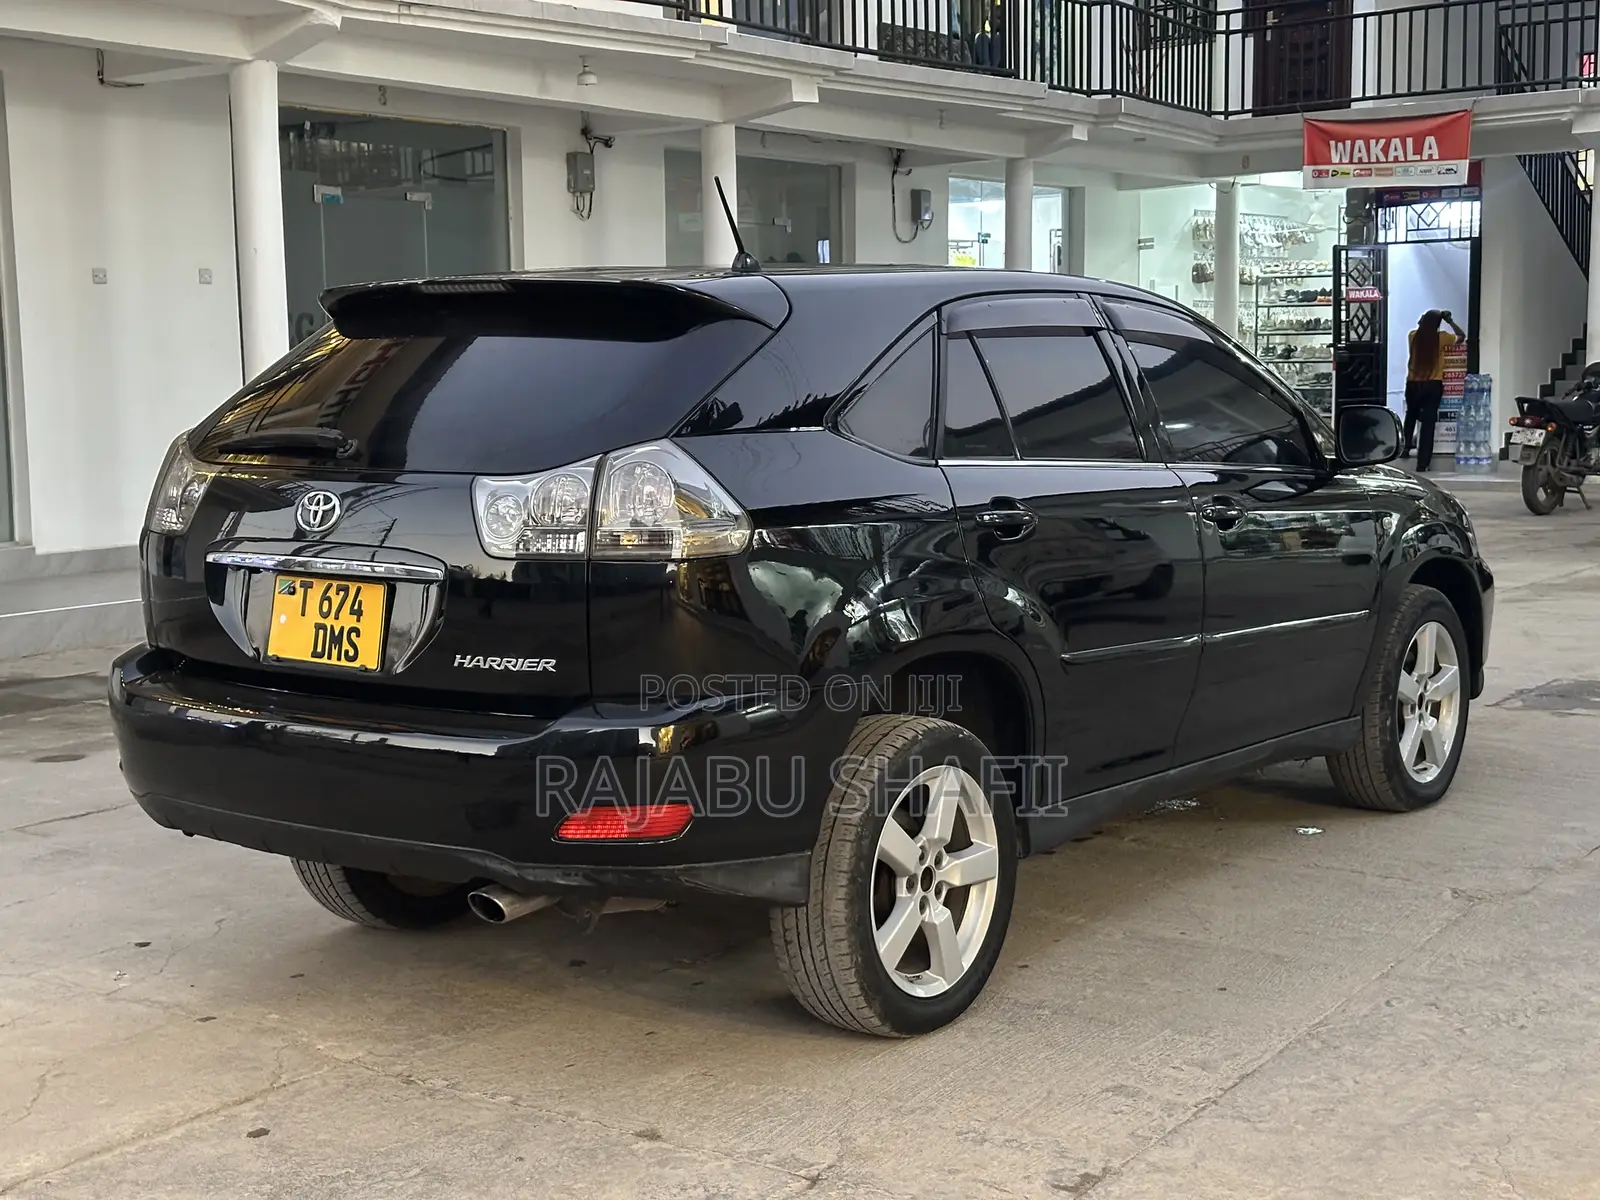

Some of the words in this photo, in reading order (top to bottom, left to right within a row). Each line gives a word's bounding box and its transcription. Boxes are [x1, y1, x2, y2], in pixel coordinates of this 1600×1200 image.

[1329, 135, 1439, 164] WAKALA
[1348, 289, 1379, 299] WAKALA
[298, 579, 314, 617] T
[318, 582, 364, 622] 674
[310, 622, 361, 663] DMS
[453, 654, 557, 674] HARRIER
